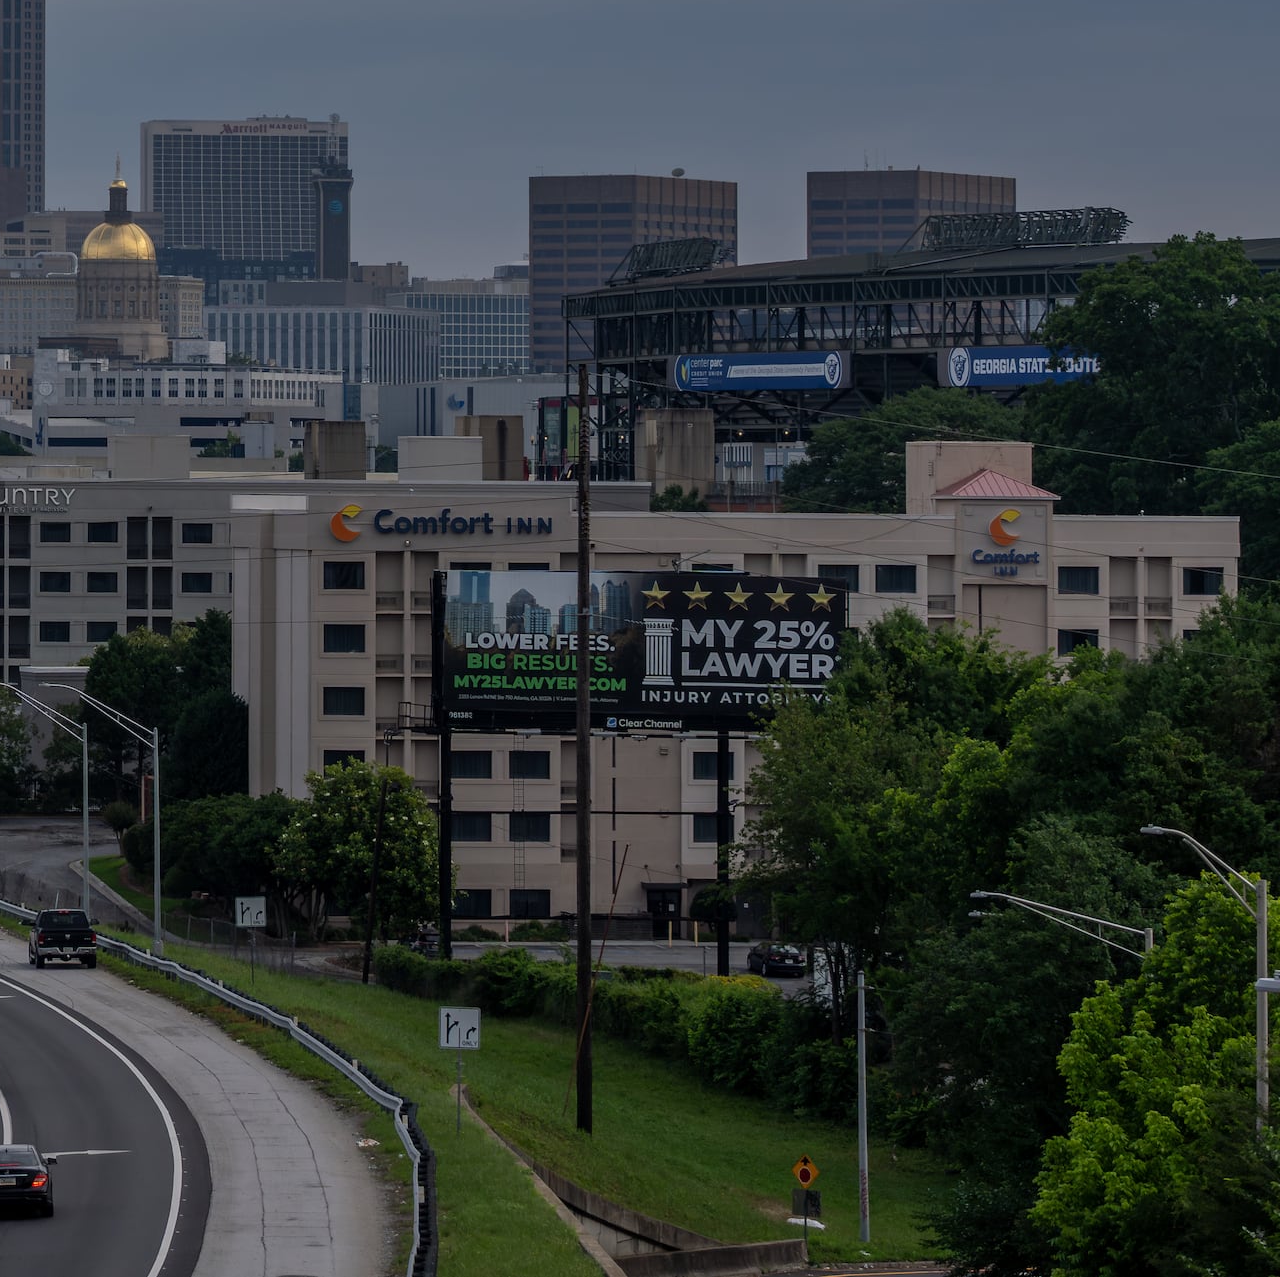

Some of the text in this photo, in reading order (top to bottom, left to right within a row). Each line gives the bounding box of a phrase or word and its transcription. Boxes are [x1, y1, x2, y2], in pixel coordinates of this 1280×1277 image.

[690, 358, 710, 368] center
[710, 358, 723, 370] parc
[973, 358, 1017, 374] GEORGIA
[1018, 357, 1054, 373] STATE
[374, 508, 553, 534] Comfort INN
[972, 548, 1040, 564] Comfort
[993, 565, 1018, 576] INN
[465, 632, 549, 651] LOWER
[681, 618, 835, 651] MY 25%
[466, 653, 507, 670] BIG
[681, 652, 834, 680] LAWYER
[453, 674, 627, 692] MY25LAWYERCOM
[641, 690, 712, 704] INJURY
[618, 718, 682, 729] Clear Channel
